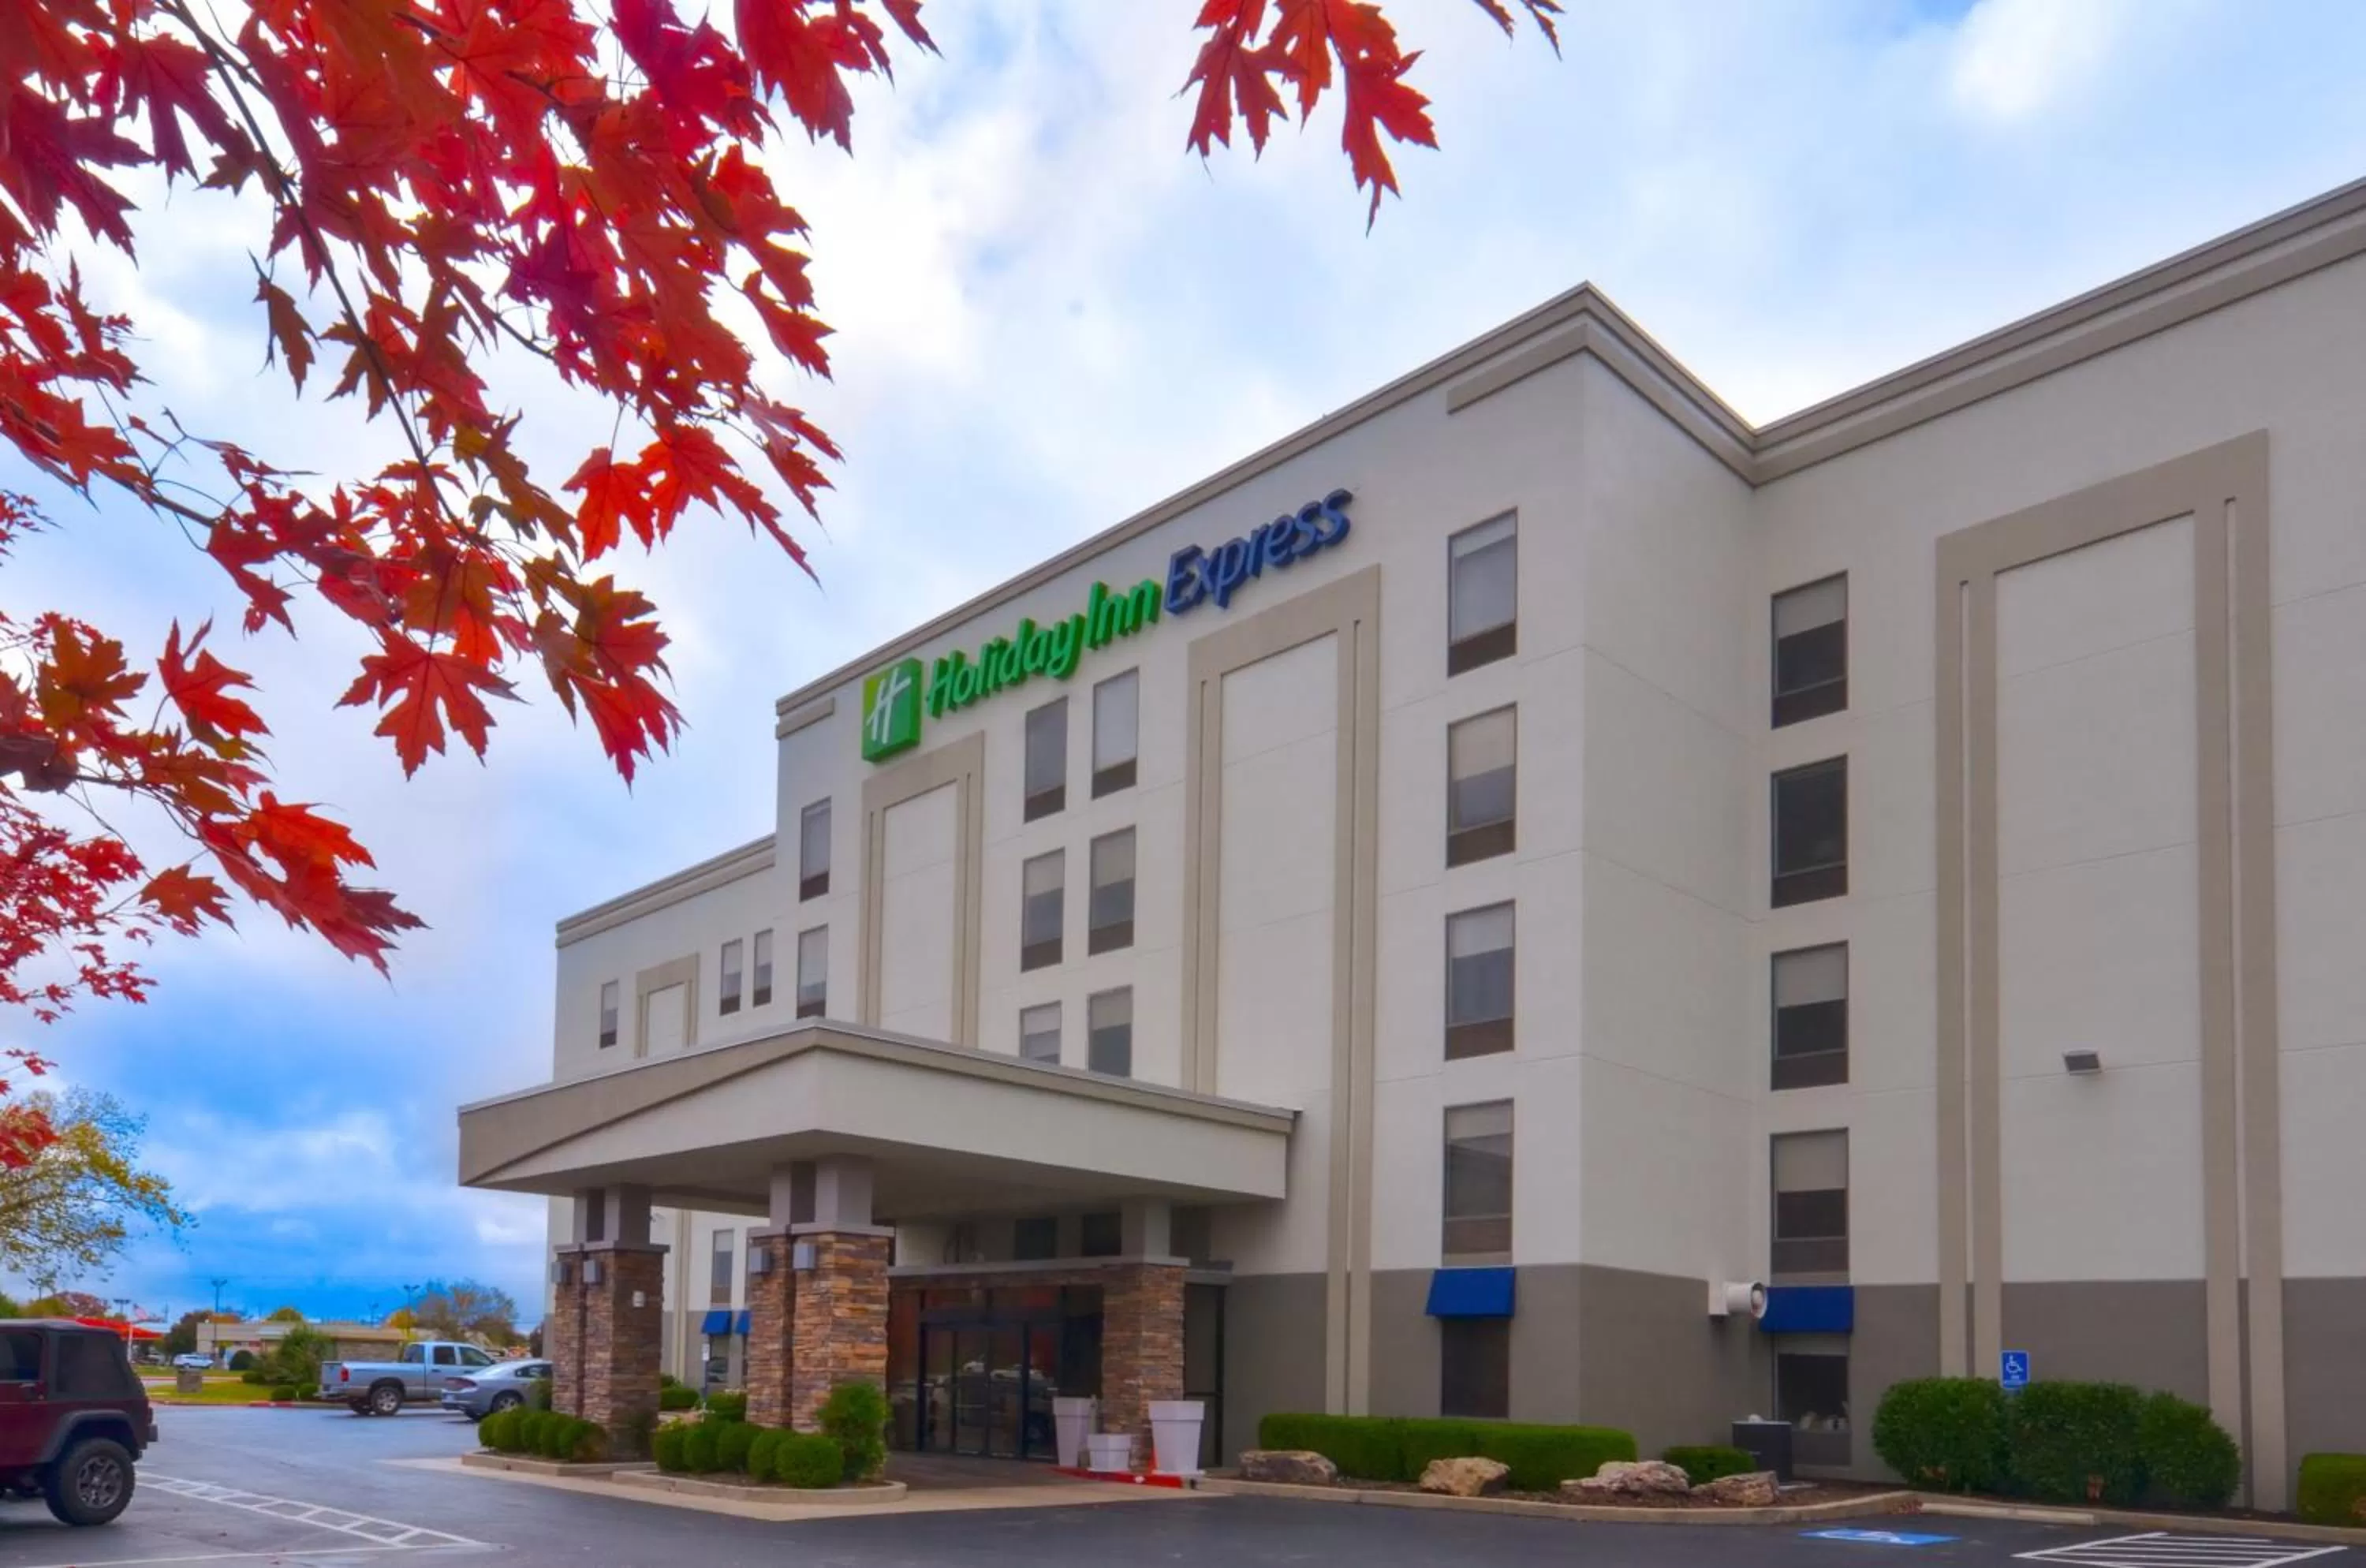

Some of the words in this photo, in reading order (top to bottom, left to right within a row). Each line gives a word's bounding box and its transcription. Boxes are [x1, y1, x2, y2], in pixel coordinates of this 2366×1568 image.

[927, 613, 1085, 718] Holiday
[1087, 579, 1162, 650] Inn
[1165, 487, 1353, 614] Express
